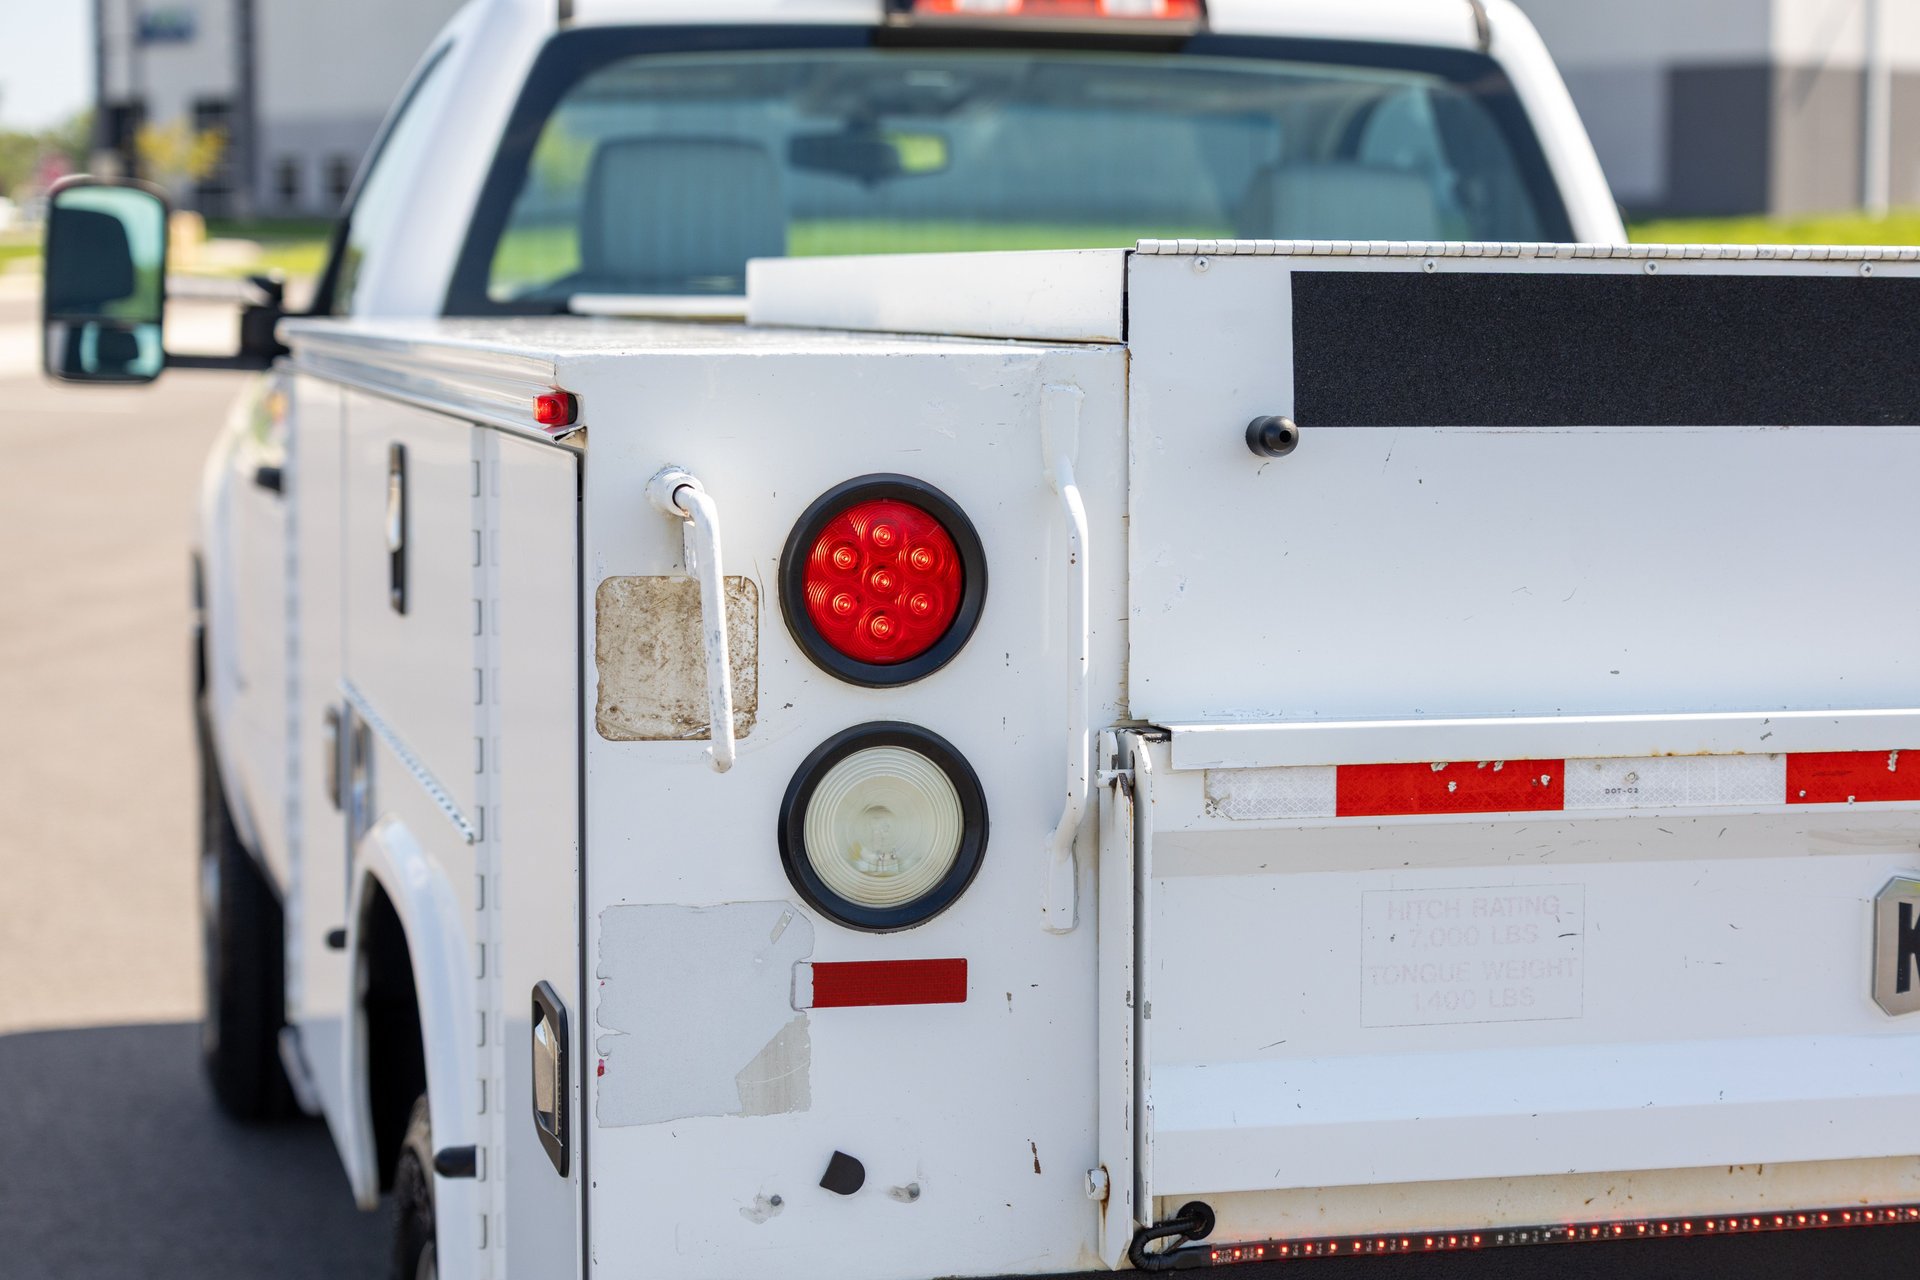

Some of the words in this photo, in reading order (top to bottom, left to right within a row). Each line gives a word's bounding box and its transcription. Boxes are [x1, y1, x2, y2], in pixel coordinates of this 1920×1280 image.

[1387, 899, 1460, 921] HITCH
[1472, 895, 1560, 918] RATING
[1491, 923, 1539, 945] LBS
[1368, 961, 1471, 986] TONGUE
[1482, 957, 1578, 981] WEIGHT
[1489, 987, 1535, 1009] LBS
